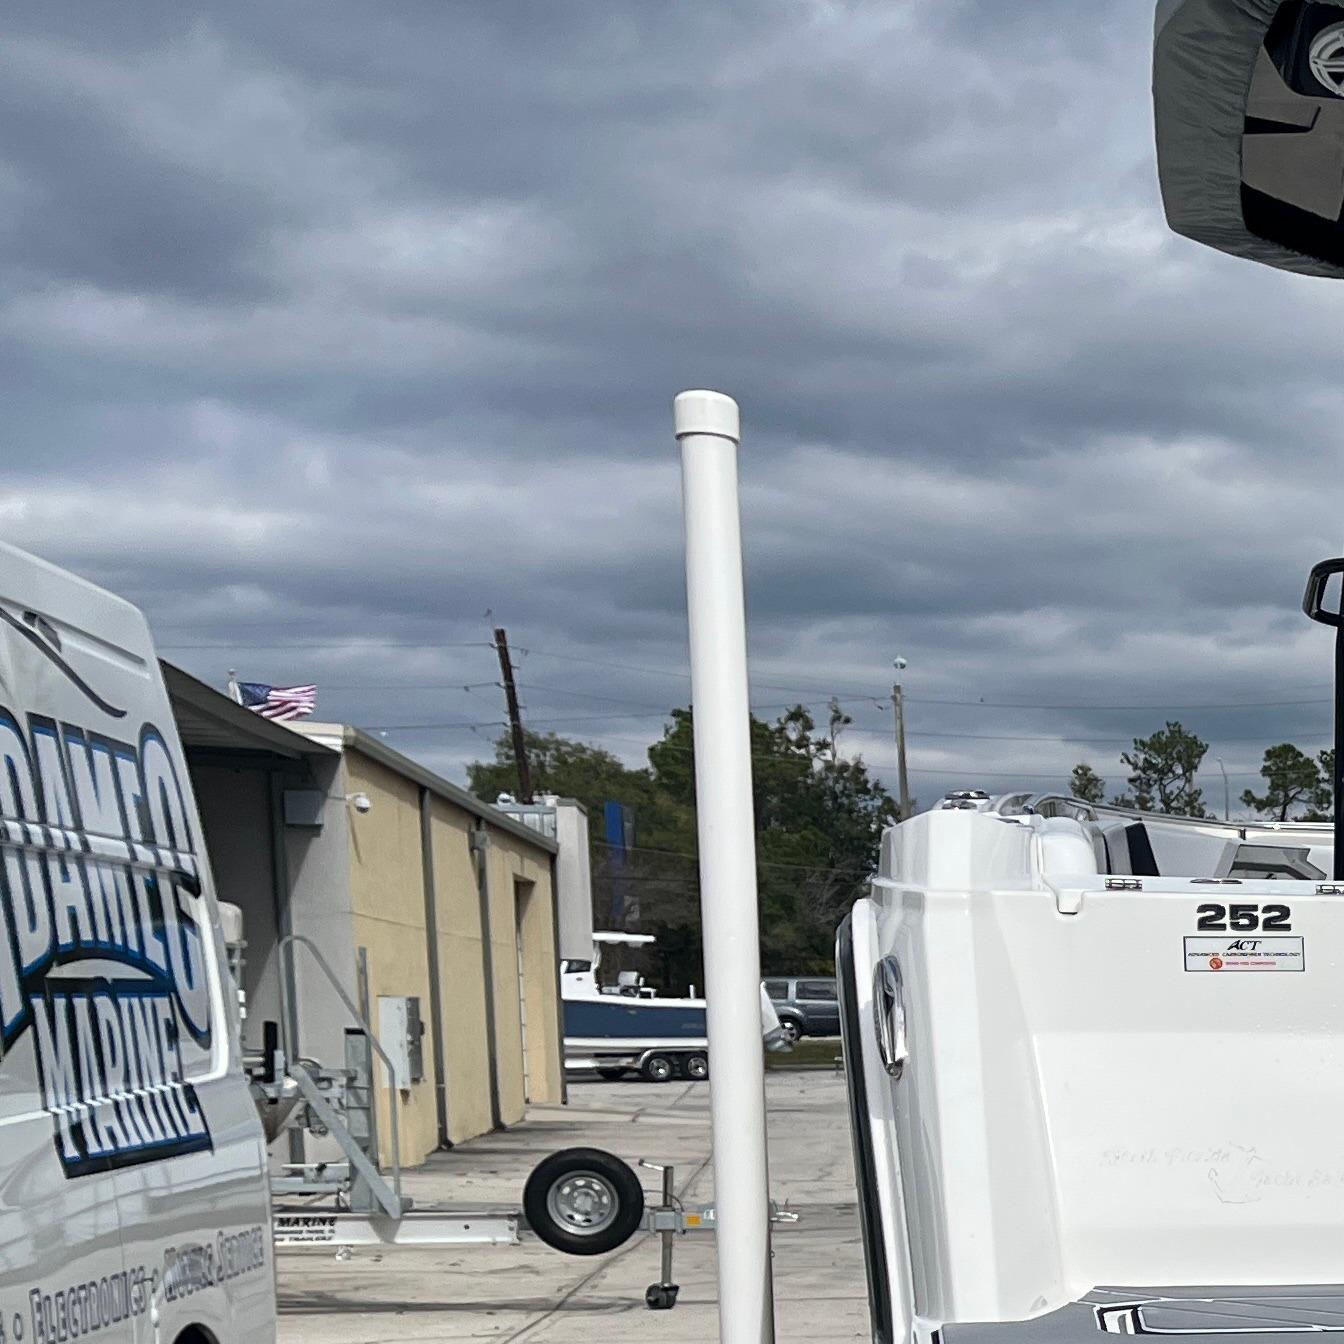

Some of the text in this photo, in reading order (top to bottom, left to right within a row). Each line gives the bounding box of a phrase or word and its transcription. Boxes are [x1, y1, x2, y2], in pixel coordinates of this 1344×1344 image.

[1196, 903, 1292, 932] 252
[1226, 939, 1262, 951] ACT
[29, 984, 213, 1178] MARINE
